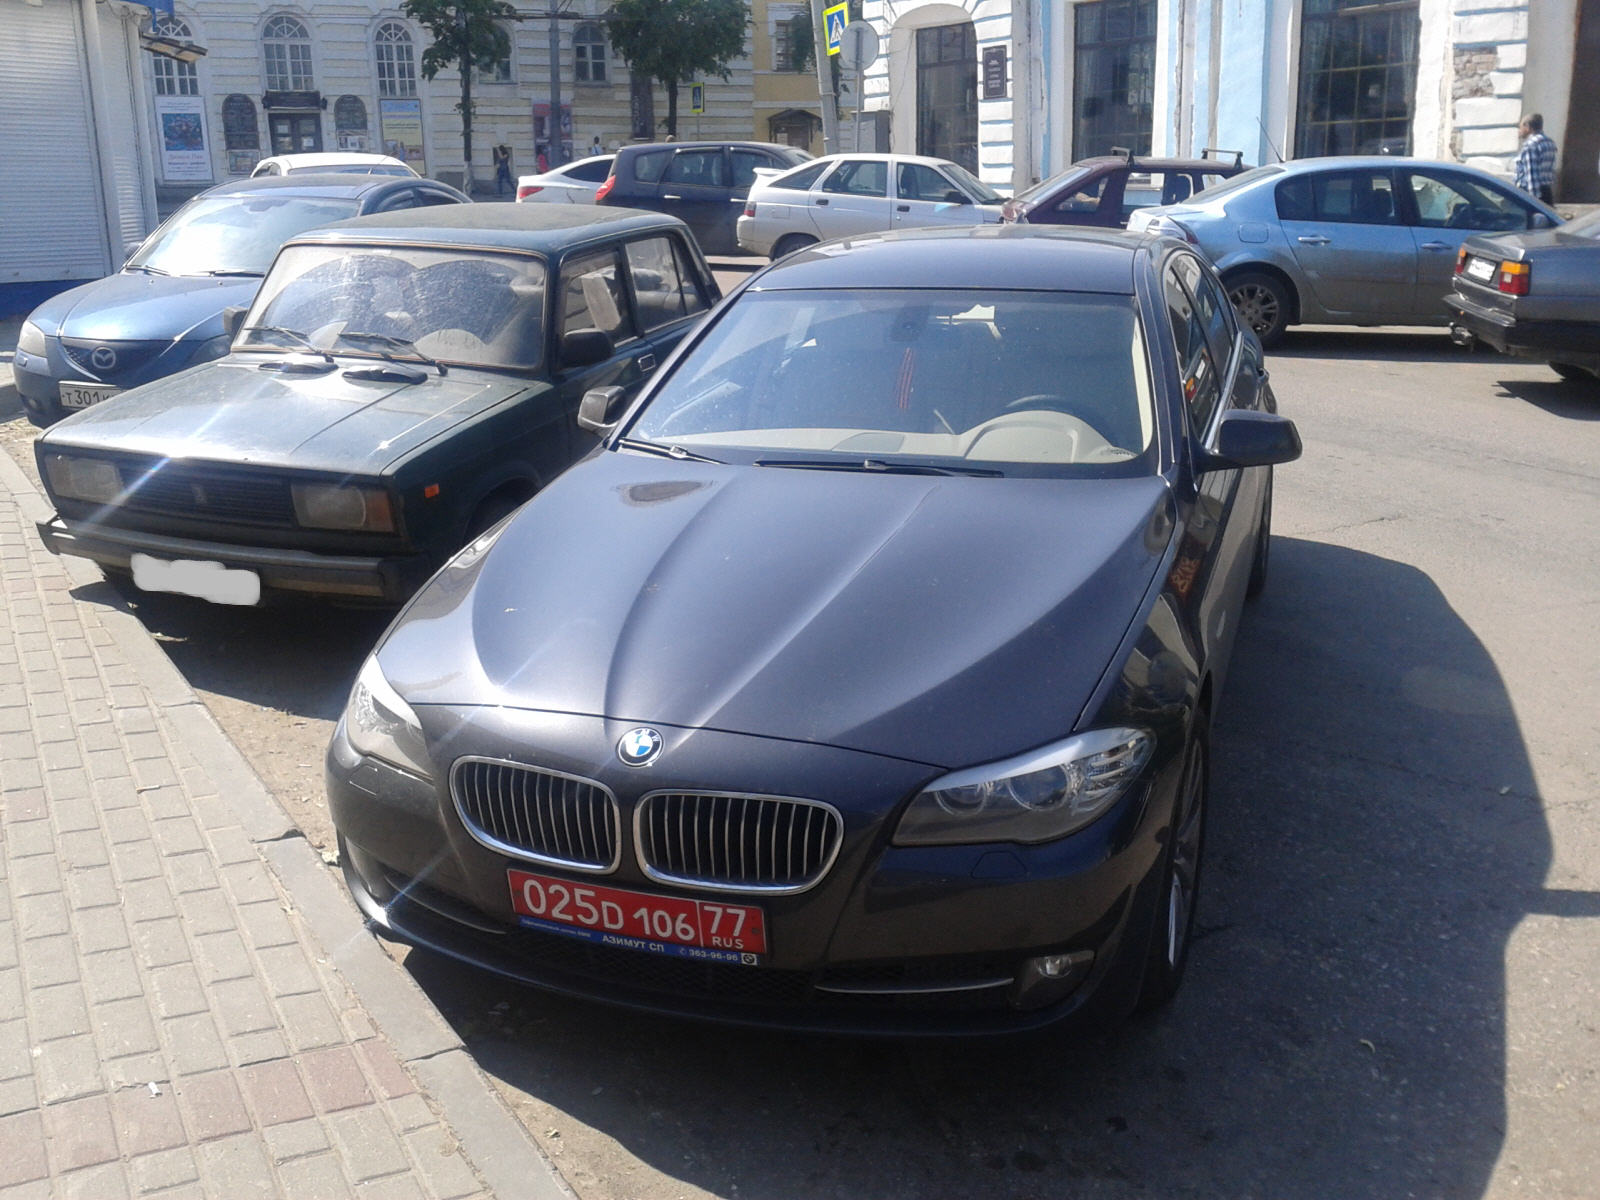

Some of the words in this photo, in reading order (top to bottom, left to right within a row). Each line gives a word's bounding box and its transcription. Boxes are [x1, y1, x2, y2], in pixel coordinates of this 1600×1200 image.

[523, 879, 625, 930] 025D
[633, 907, 696, 941] 106
[703, 905, 746, 937] 77
[602, 935, 646, 949] АЗИМУТ
[649, 943, 665, 953] СП
[712, 936, 745, 950] RUS
